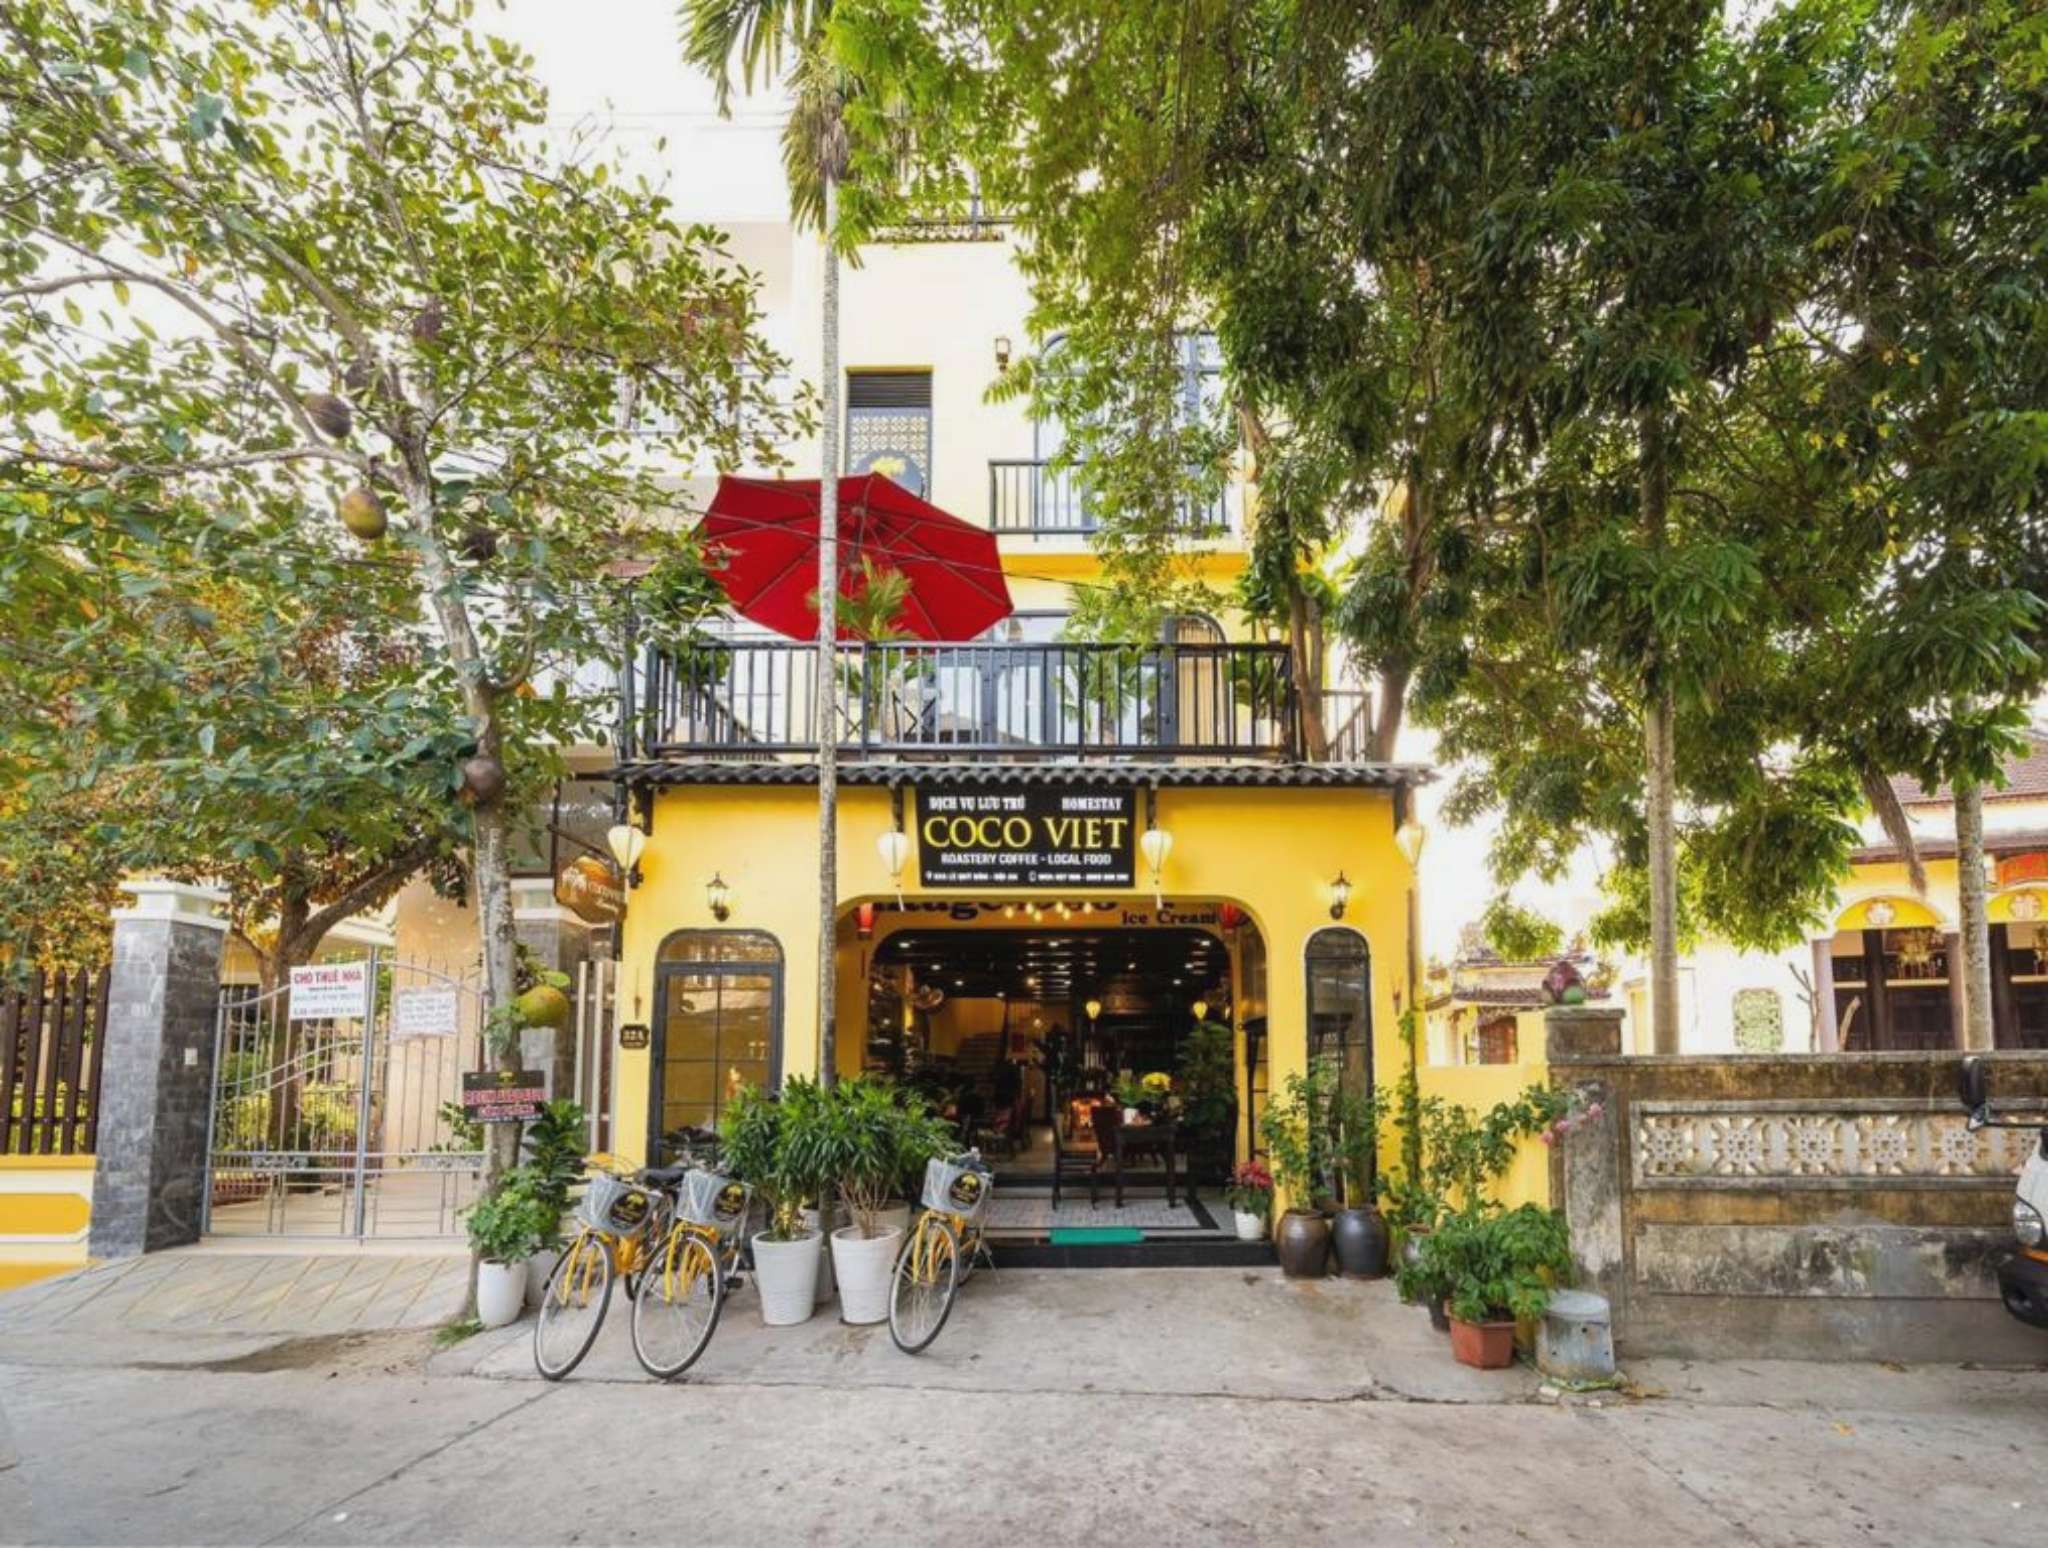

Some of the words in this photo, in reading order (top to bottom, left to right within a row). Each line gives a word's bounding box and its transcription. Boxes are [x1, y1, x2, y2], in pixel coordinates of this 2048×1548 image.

[1061, 797, 1123, 811] HOMESTAY
[923, 816, 1033, 849] COCO
[1041, 816, 1128, 849] VIET
[940, 853, 997, 866] ROASTERY
[998, 853, 1039, 866] COFFEE
[1047, 853, 1081, 866] LOCAL
[1083, 854, 1112, 866] FOOD
[1121, 909, 1149, 925] Ice
[1156, 909, 1217, 925] Cream
